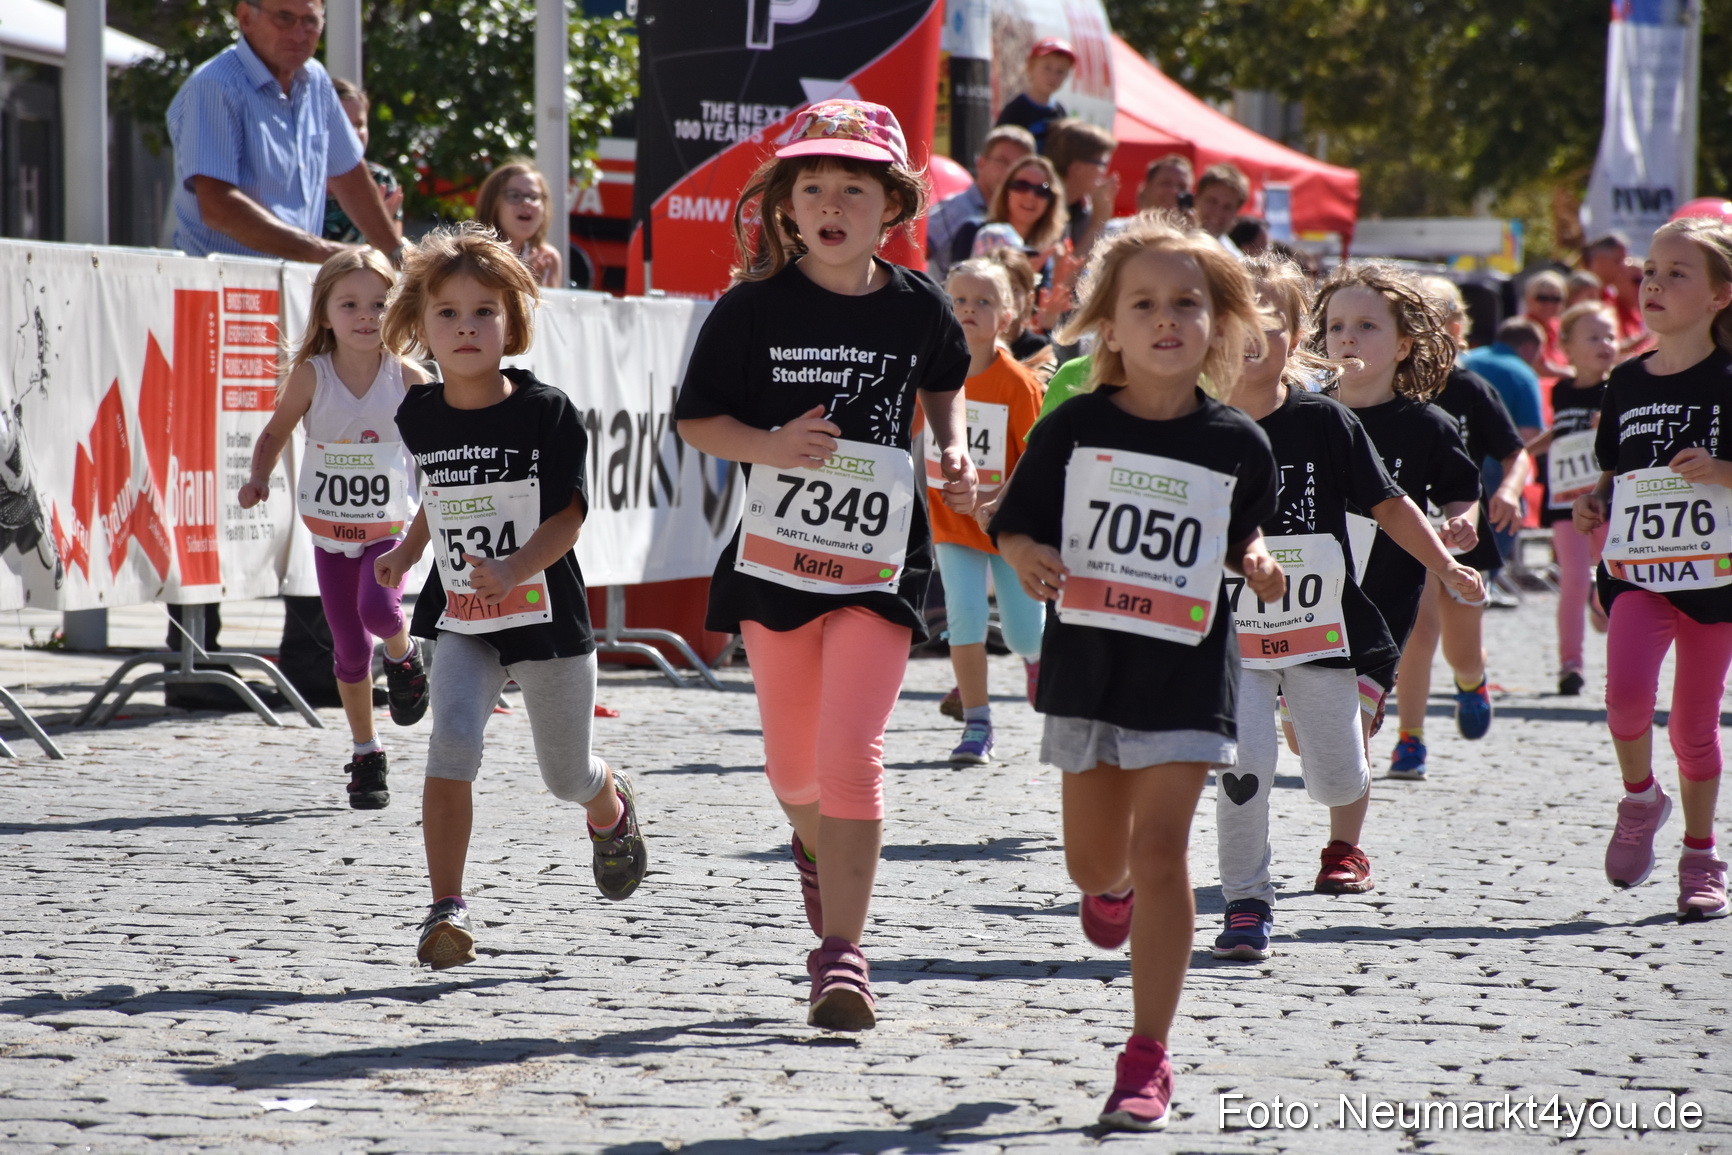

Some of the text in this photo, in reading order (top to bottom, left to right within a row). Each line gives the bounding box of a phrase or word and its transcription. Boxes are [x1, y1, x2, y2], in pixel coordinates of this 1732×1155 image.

[701, 101, 790, 126] THE NEXT
[674, 119, 765, 144] 100 YEARS
[668, 196, 731, 222] BMW
[769, 345, 877, 364] Neumarkter
[772, 367, 853, 388] Stadtlauf
[325, 453, 375, 466] BOCK
[824, 454, 875, 476] OCK
[171, 455, 215, 527] Braun
[314, 471, 390, 508] 7099
[1109, 467, 1189, 499] BOCK
[1636, 477, 1693, 494] BOCK
[440, 496, 495, 515] BOCK
[751, 503, 762, 513] B1
[775, 474, 889, 537] 7349
[1304, 462, 1316, 534] BAMBIN
[318, 508, 339, 518] PARTL
[1624, 499, 1715, 542] 7576
[333, 525, 367, 540] Viola
[776, 527, 859, 551] PARTL Neumarkt
[1088, 500, 1202, 568] 7050
[1628, 543, 1698, 554] PARTL Neumarkt
[793, 552, 843, 580] Karla
[1087, 560, 1174, 584] PARTL Neumarkt
[1633, 561, 1699, 583] LINA
[1104, 587, 1153, 615] Lara
[1235, 616, 1302, 628] PARTL Neumarkt
[1261, 638, 1289, 654] Eva
